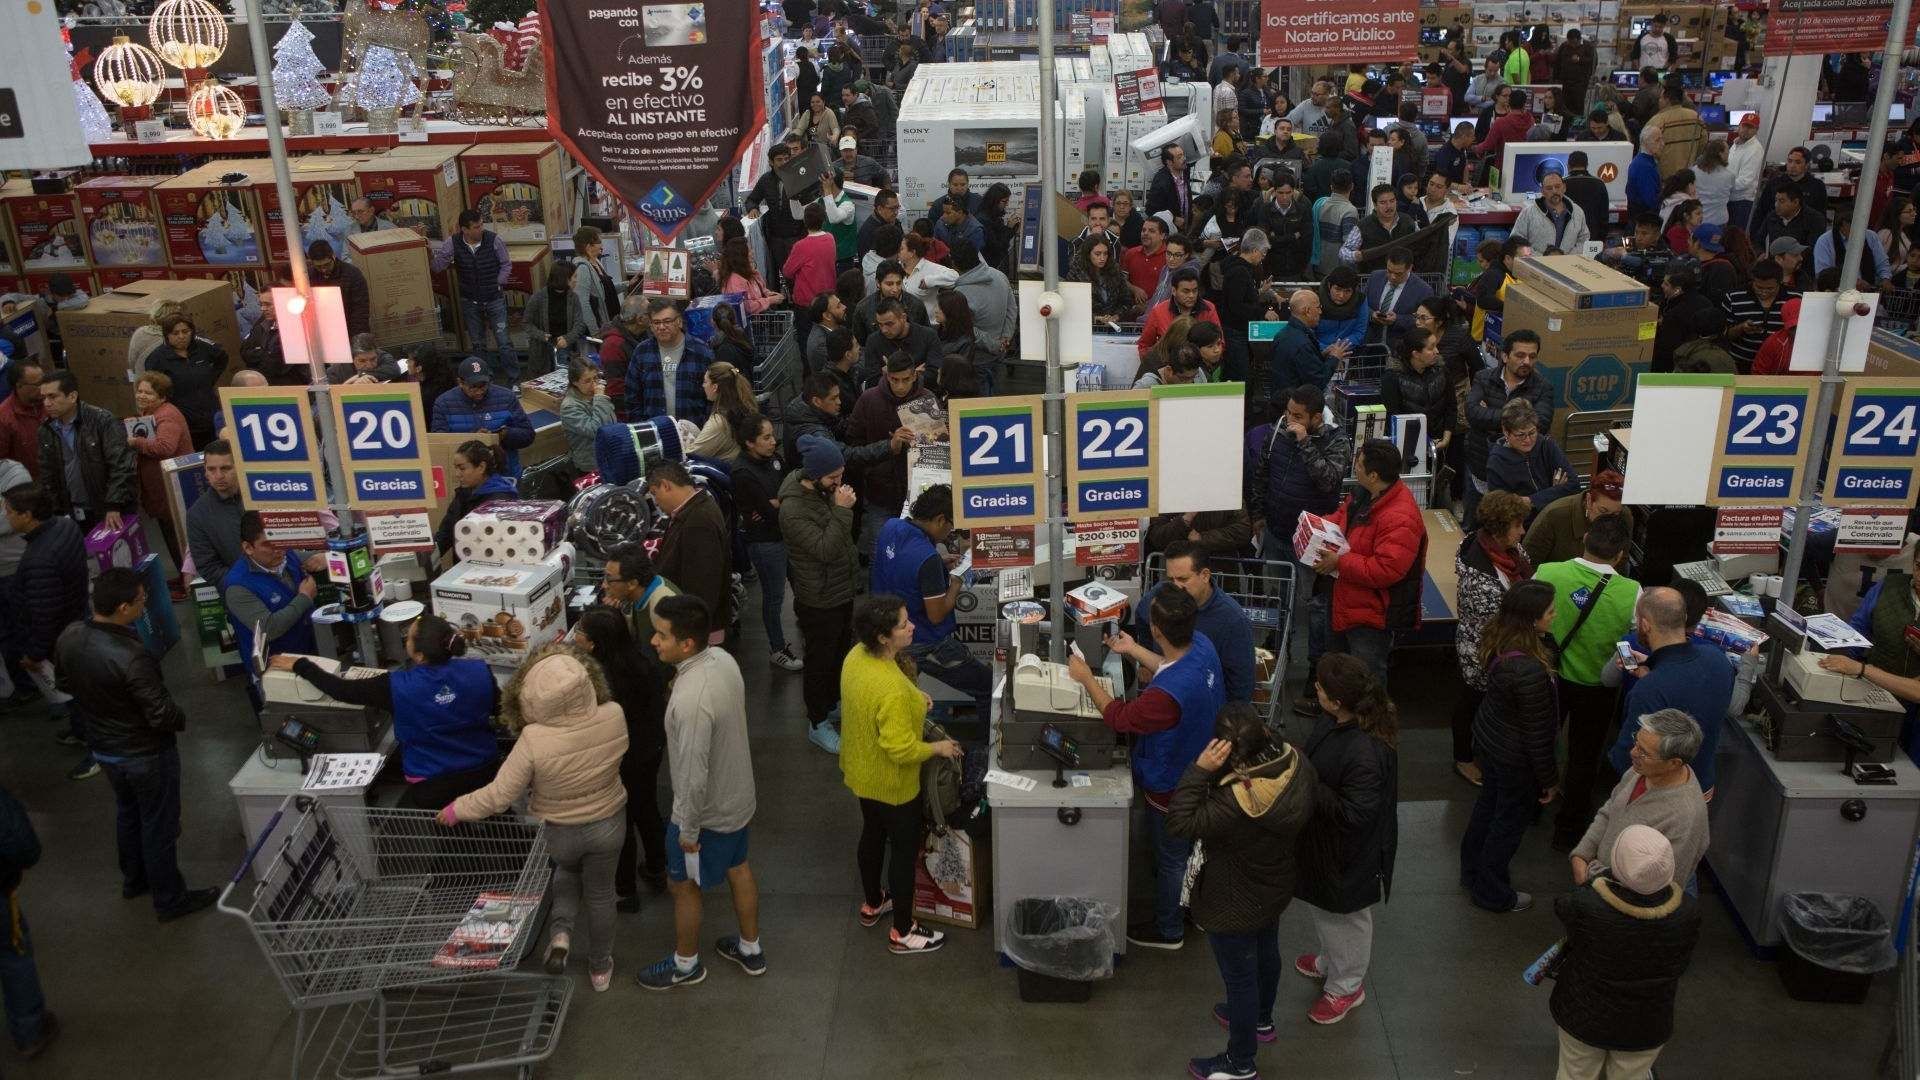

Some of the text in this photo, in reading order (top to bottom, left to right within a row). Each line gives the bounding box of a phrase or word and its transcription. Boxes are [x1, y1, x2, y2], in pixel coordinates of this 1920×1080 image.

[589, 7, 638, 19] pagando
[1267, 10, 1414, 26] los certificamos ante
[619, 19, 639, 27] con
[1286, 28, 1395, 43] Notario Público
[628, 54, 672, 64] Además
[602, 66, 703, 92] recibe 3%
[605, 92, 704, 110] en efectivo
[607, 109, 706, 125] AL INSTANTE
[578, 128, 623, 140] Aceptada
[626, 132, 654, 141] como
[657, 130, 684, 142] pago
[700, 127, 738, 138] efectivo
[1577, 375, 1619, 393] STOP
[1584, 394, 1608, 402] ALTO
[350, 410, 411, 450] 20
[1732, 404, 1798, 444] 23
[1850, 404, 1916, 445] 24
[240, 412, 298, 452] 19
[1083, 416, 1144, 459] 22
[969, 423, 1026, 466] 21
[254, 480, 308, 492] Gracias
[362, 478, 418, 490] Gracias
[1727, 475, 1784, 488] Gracias
[1844, 476, 1902, 488] Gracias
[970, 494, 1027, 508] Gracias
[1086, 488, 1142, 502] Gracias
[383, 529, 422, 538] Consérvalo
[1078, 532, 1105, 542] $200
[1112, 530, 1136, 538] $100
[1850, 530, 1892, 538] Consérvalo
[976, 541, 986, 550] 4
